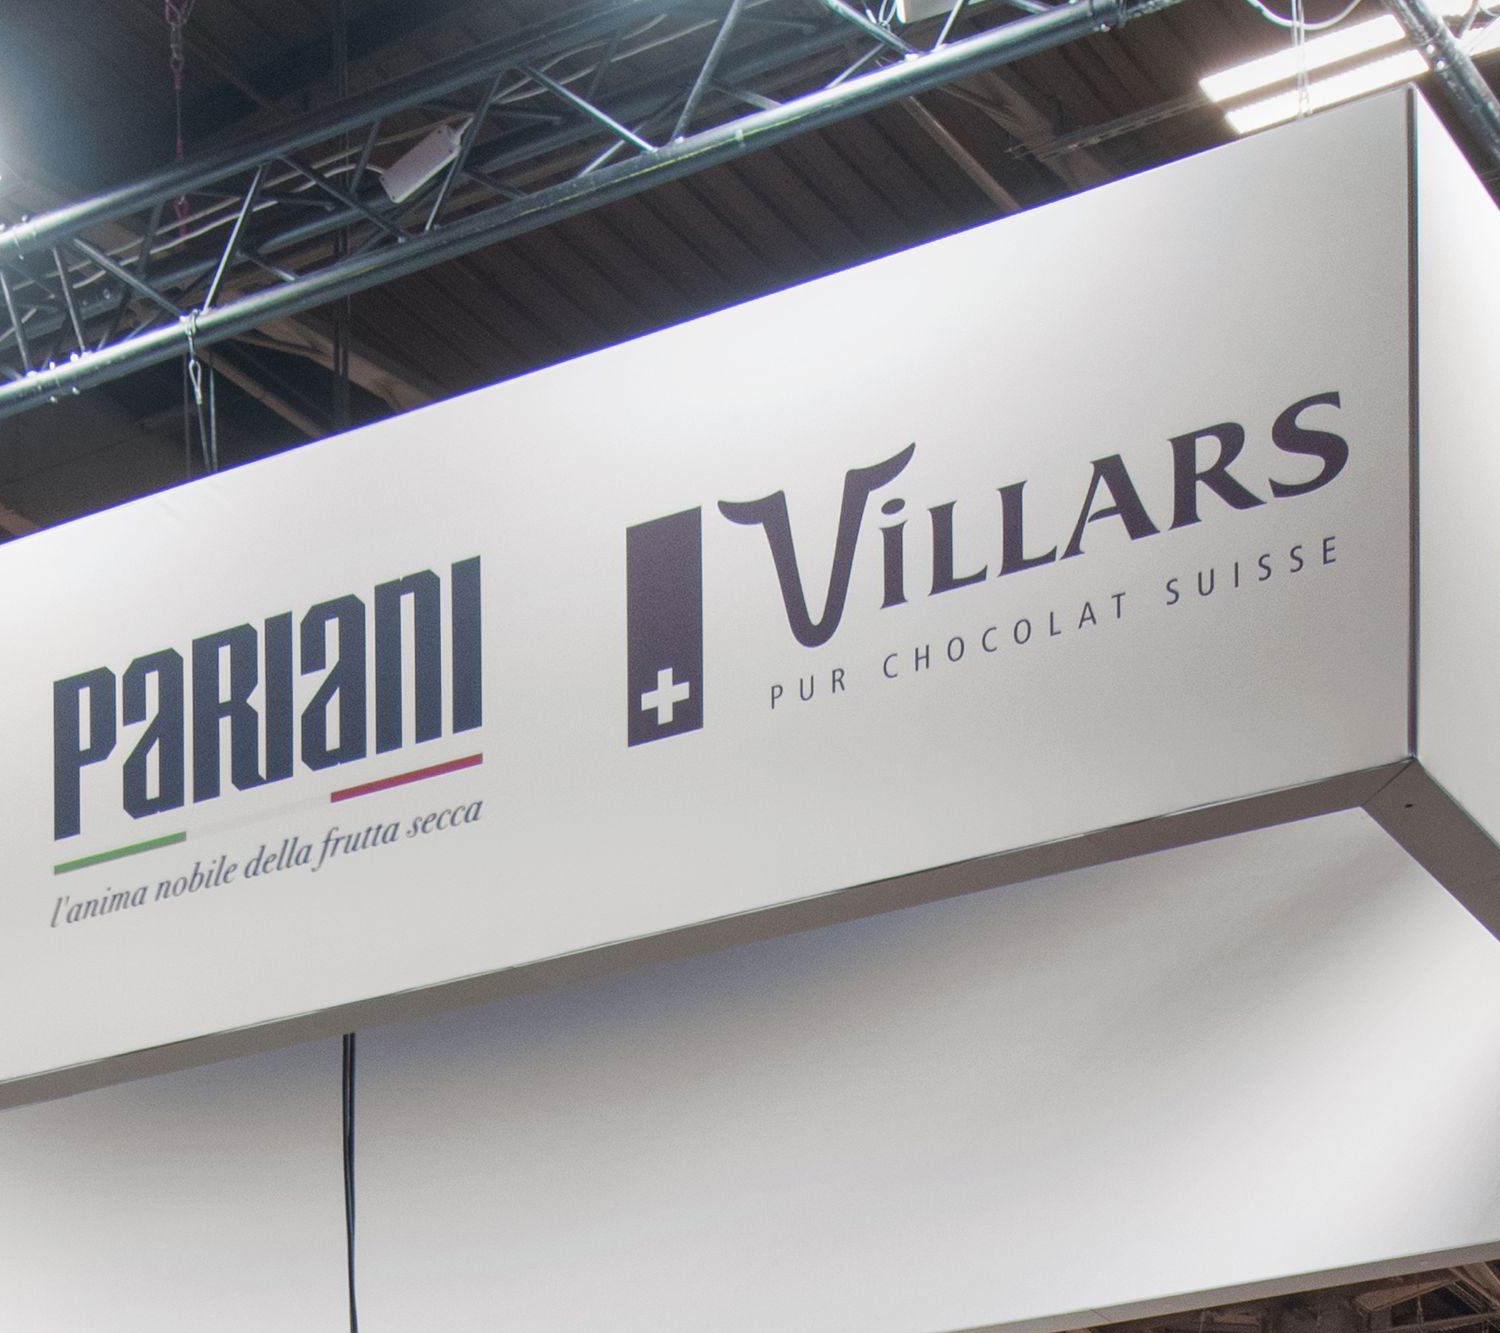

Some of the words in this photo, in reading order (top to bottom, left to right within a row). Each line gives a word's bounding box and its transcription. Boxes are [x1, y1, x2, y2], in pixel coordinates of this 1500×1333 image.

[769, 667, 847, 709] PUR
[882, 591, 1127, 679] CHOCOLAT
[1165, 536, 1338, 605] SUISSE
[50, 887, 147, 928] l'anima
[155, 855, 237, 902] nobile
[244, 836, 312, 879] della
[312, 821, 400, 872] frutta
[406, 800, 483, 839] secca
